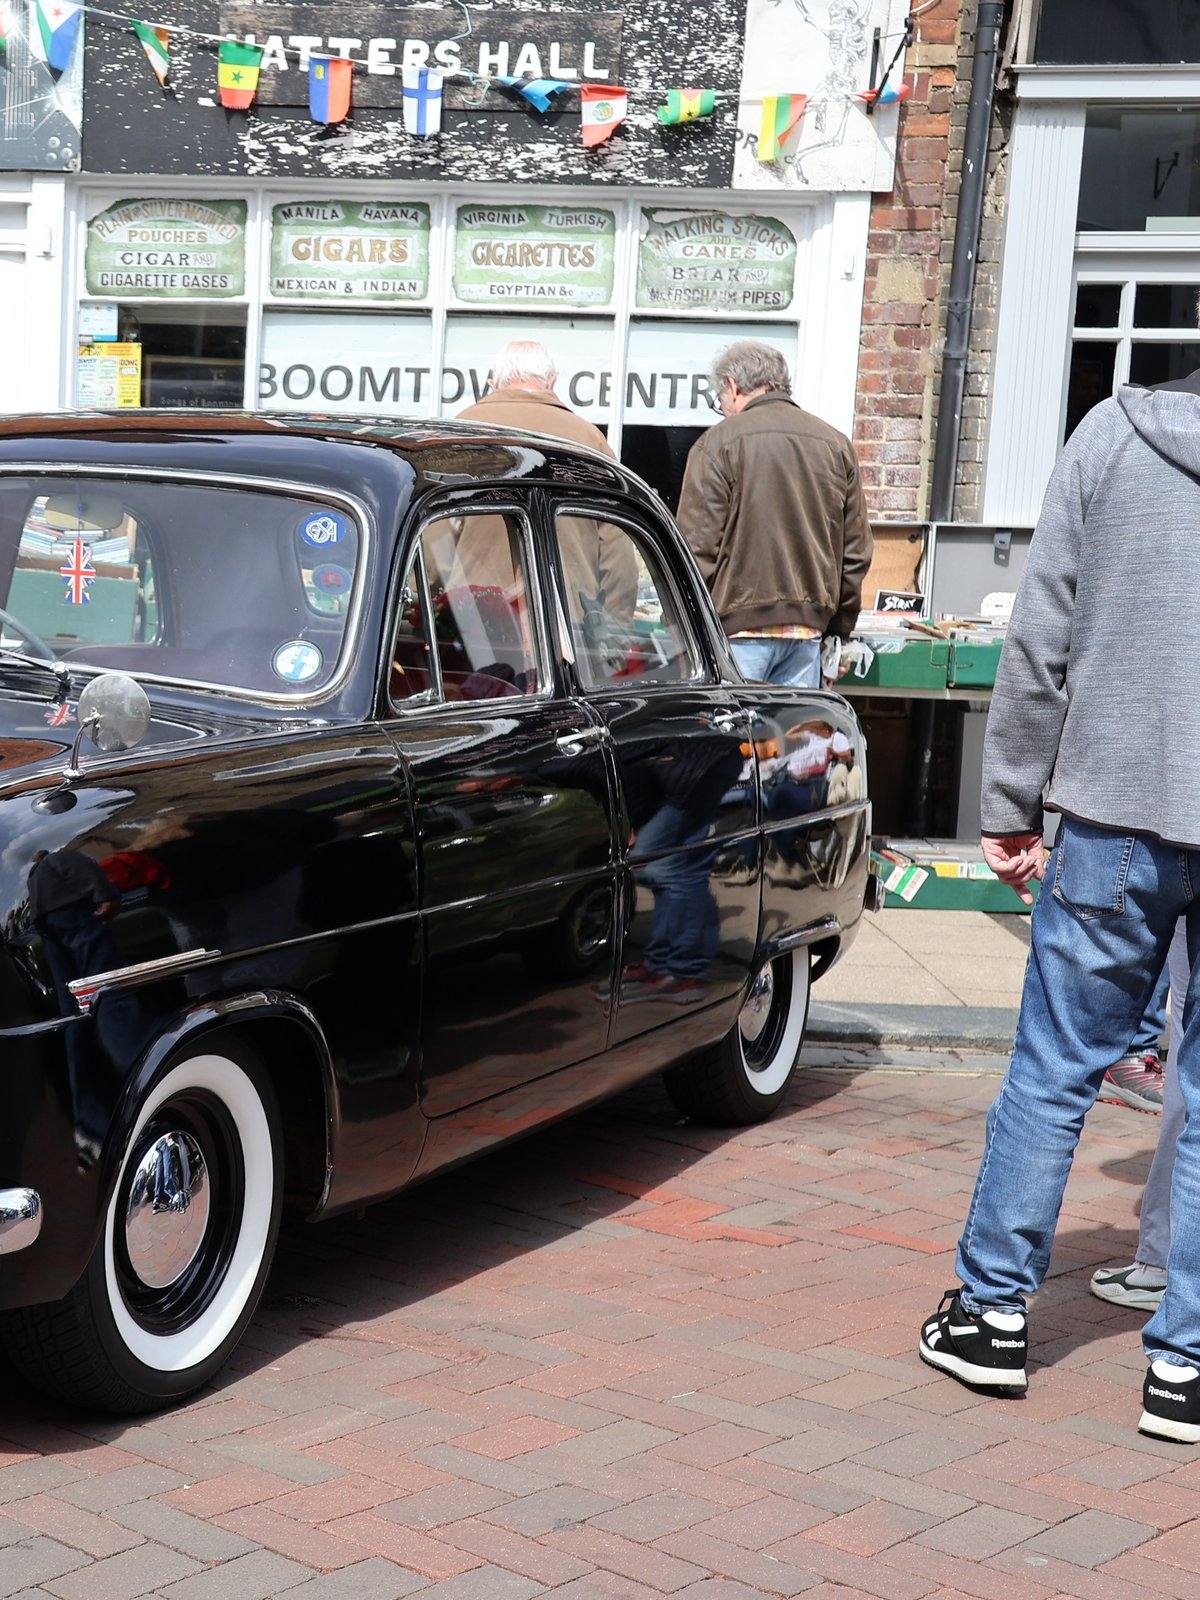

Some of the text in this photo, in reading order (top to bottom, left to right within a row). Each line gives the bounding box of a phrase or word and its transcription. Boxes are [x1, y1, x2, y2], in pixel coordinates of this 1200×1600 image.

[226, 33, 611, 79] ATTERS HALL
[281, 206, 420, 222] MANILA HAVANA
[463, 211, 607, 229] VIRGINIA TURKISH
[127, 230, 209, 243] POUCHES
[651, 215, 789, 256] WALKING STICKS
[710, 236, 732, 245] AND
[291, 236, 408, 264] CIGARS
[472, 241, 595, 268] CIGARETTES
[682, 245, 758, 259] CANES
[120, 251, 190, 266] CIGAR
[100, 273, 229, 288] CIGARETTE CASES
[276, 279, 417, 294] MEXICAN & INDIAN
[490, 284, 556, 296] EGYPTIAN
[742, 290, 781, 305] PIPES
[259, 363, 714, 409] BOOMTO CENTR
[991, 1338, 1026, 1349] Reebok
[1147, 1384, 1187, 1403] Reebok
